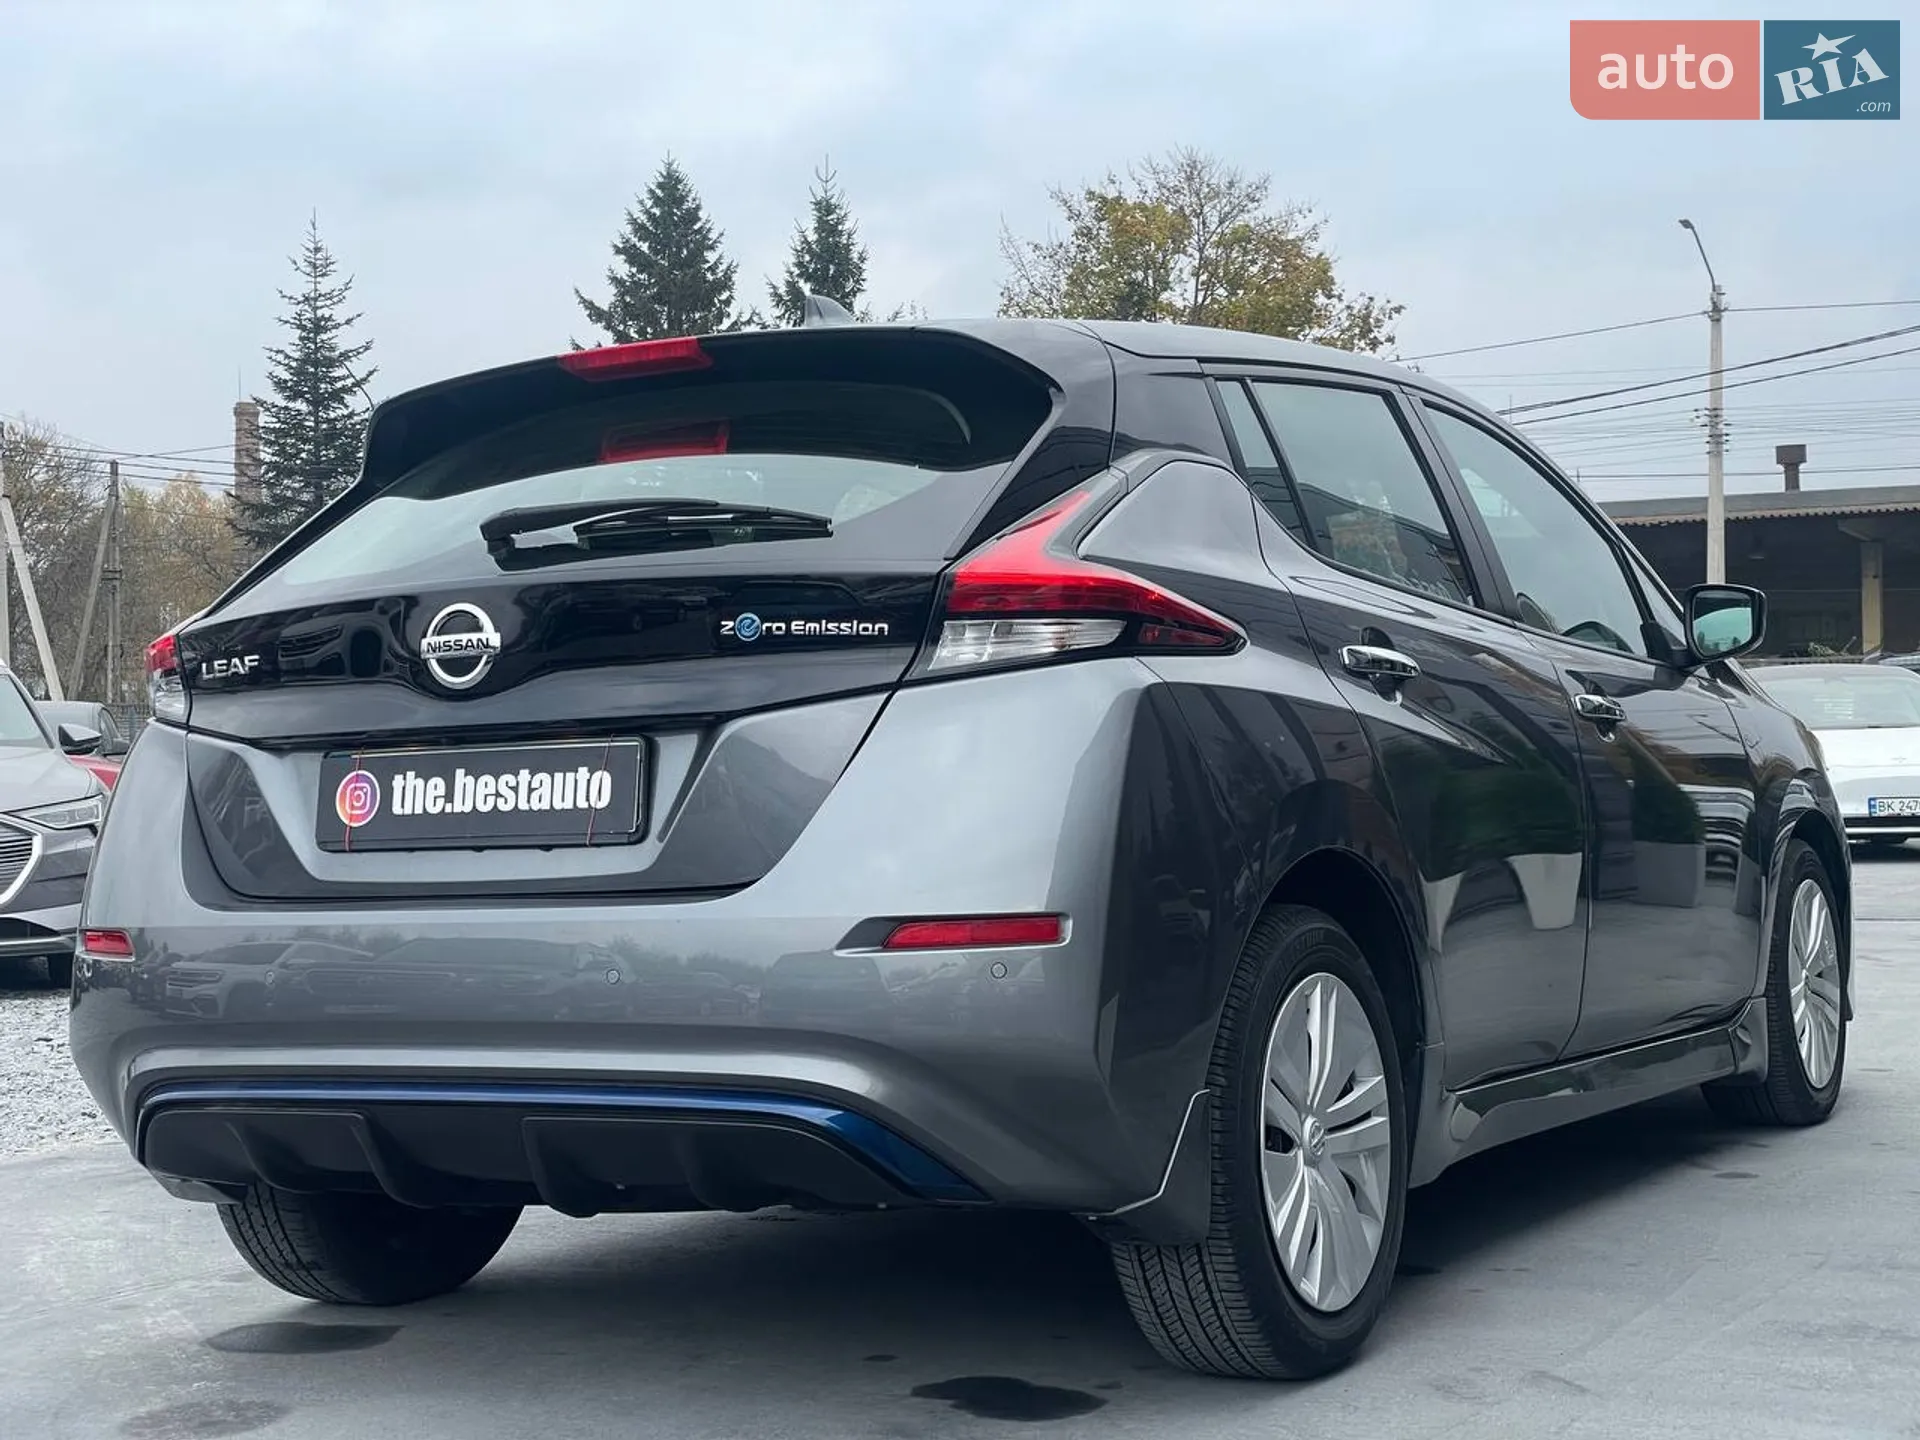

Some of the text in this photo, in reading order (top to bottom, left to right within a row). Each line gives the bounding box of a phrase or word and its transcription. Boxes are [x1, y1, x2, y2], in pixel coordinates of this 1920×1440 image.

[791, 619, 889, 636] Emission
[426, 636, 490, 654] NISSAN
[201, 655, 260, 680] LEAF
[391, 766, 612, 816] the.bestauto
[1878, 800, 1920, 812] BK 247
